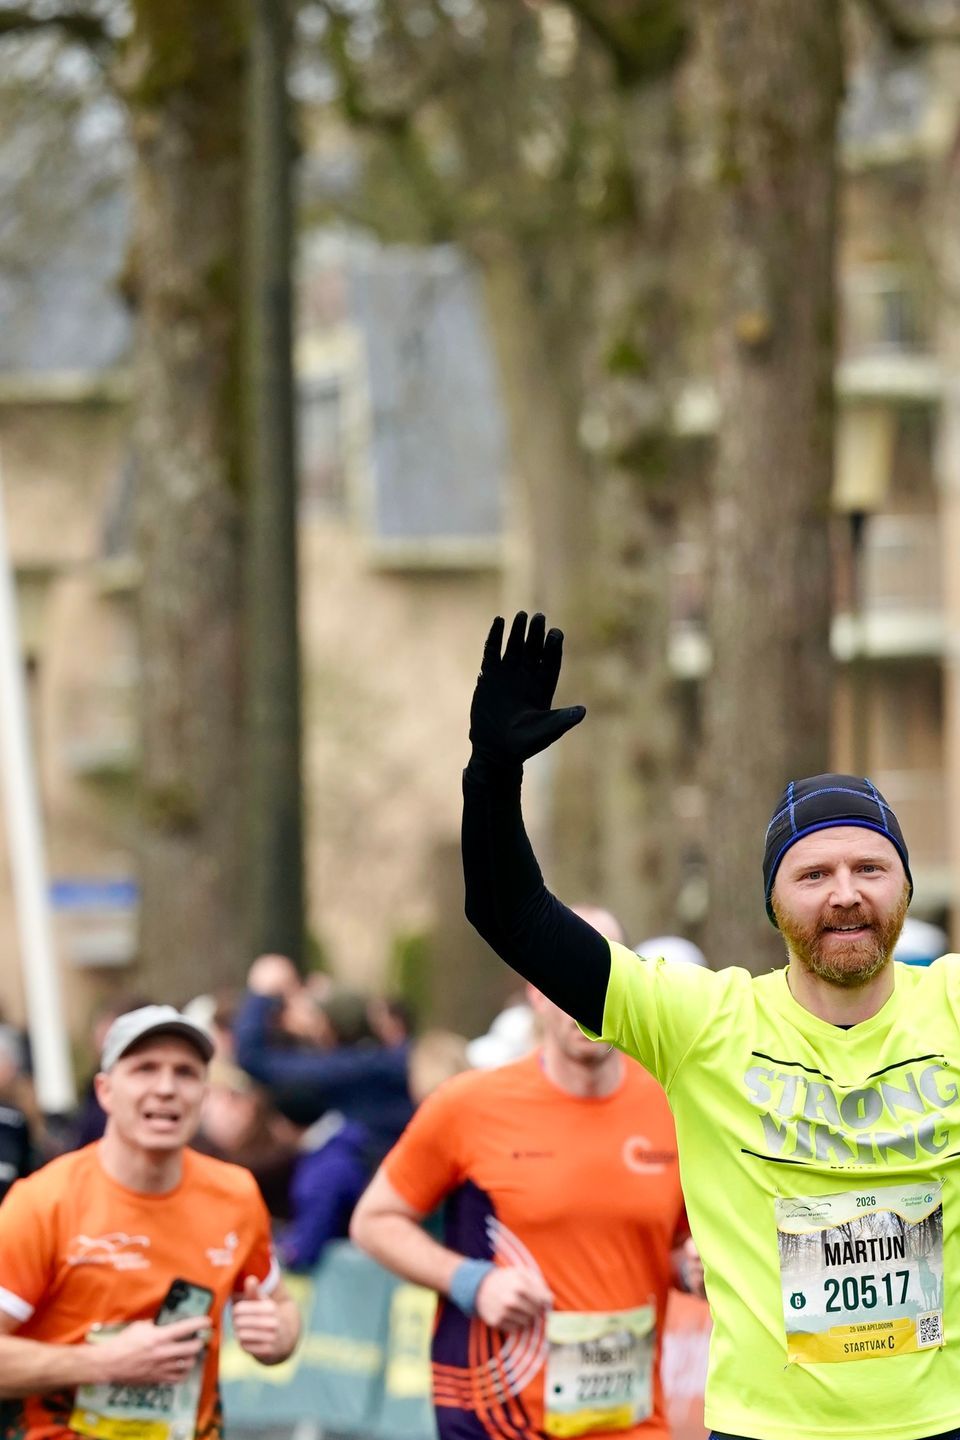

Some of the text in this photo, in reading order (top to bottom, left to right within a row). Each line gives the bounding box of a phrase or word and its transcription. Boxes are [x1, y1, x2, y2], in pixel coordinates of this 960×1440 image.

[744, 1065, 958, 1129] STRONG
[760, 1112, 949, 1165] VIKING
[856, 1196, 876, 1207] 2026
[824, 1236, 906, 1267] MARTIJN
[824, 1270, 910, 1313] 20517
[844, 1335, 895, 1353] STARTVAK C
